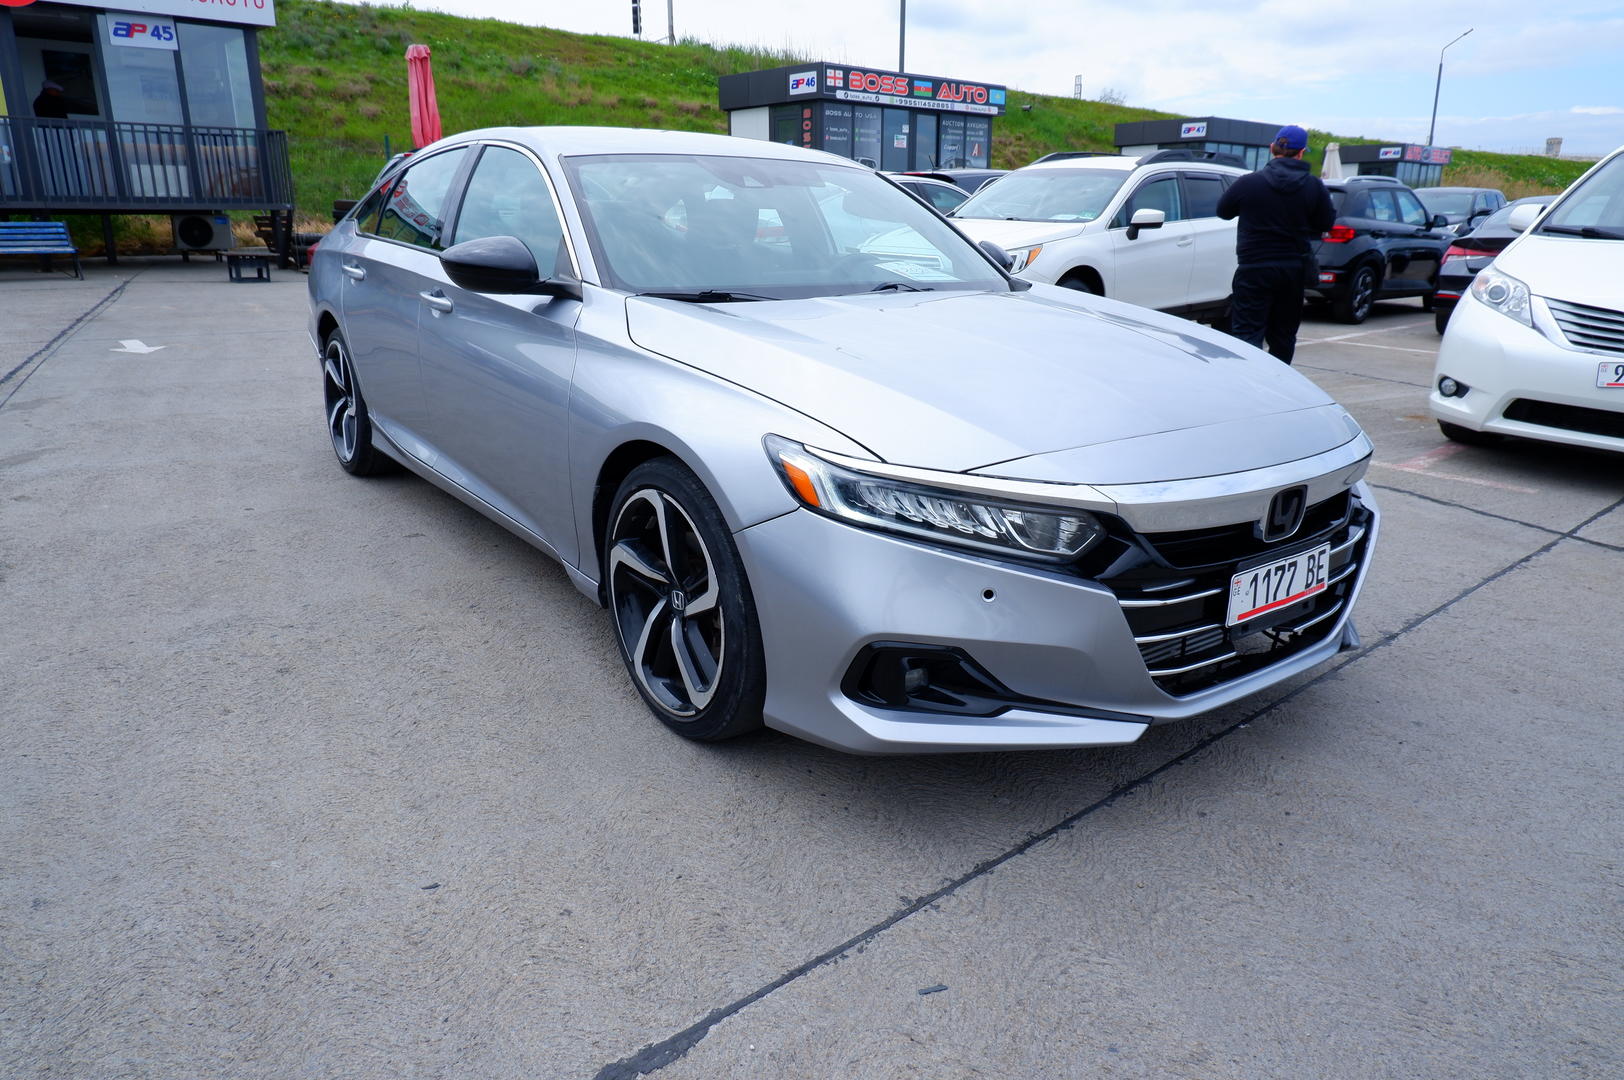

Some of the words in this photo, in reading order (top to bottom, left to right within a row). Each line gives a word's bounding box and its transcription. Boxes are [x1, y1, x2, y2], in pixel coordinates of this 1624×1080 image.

[150, 24, 174, 42] 45
[805, 76, 816, 87] 46
[848, 71, 909, 96] BOSS
[936, 82, 988, 104] AUTO
[825, 109, 842, 117] BOSS
[942, 120, 965, 129] AUCTION
[1249, 560, 1298, 609] 1177
[1304, 549, 1327, 590] BE
